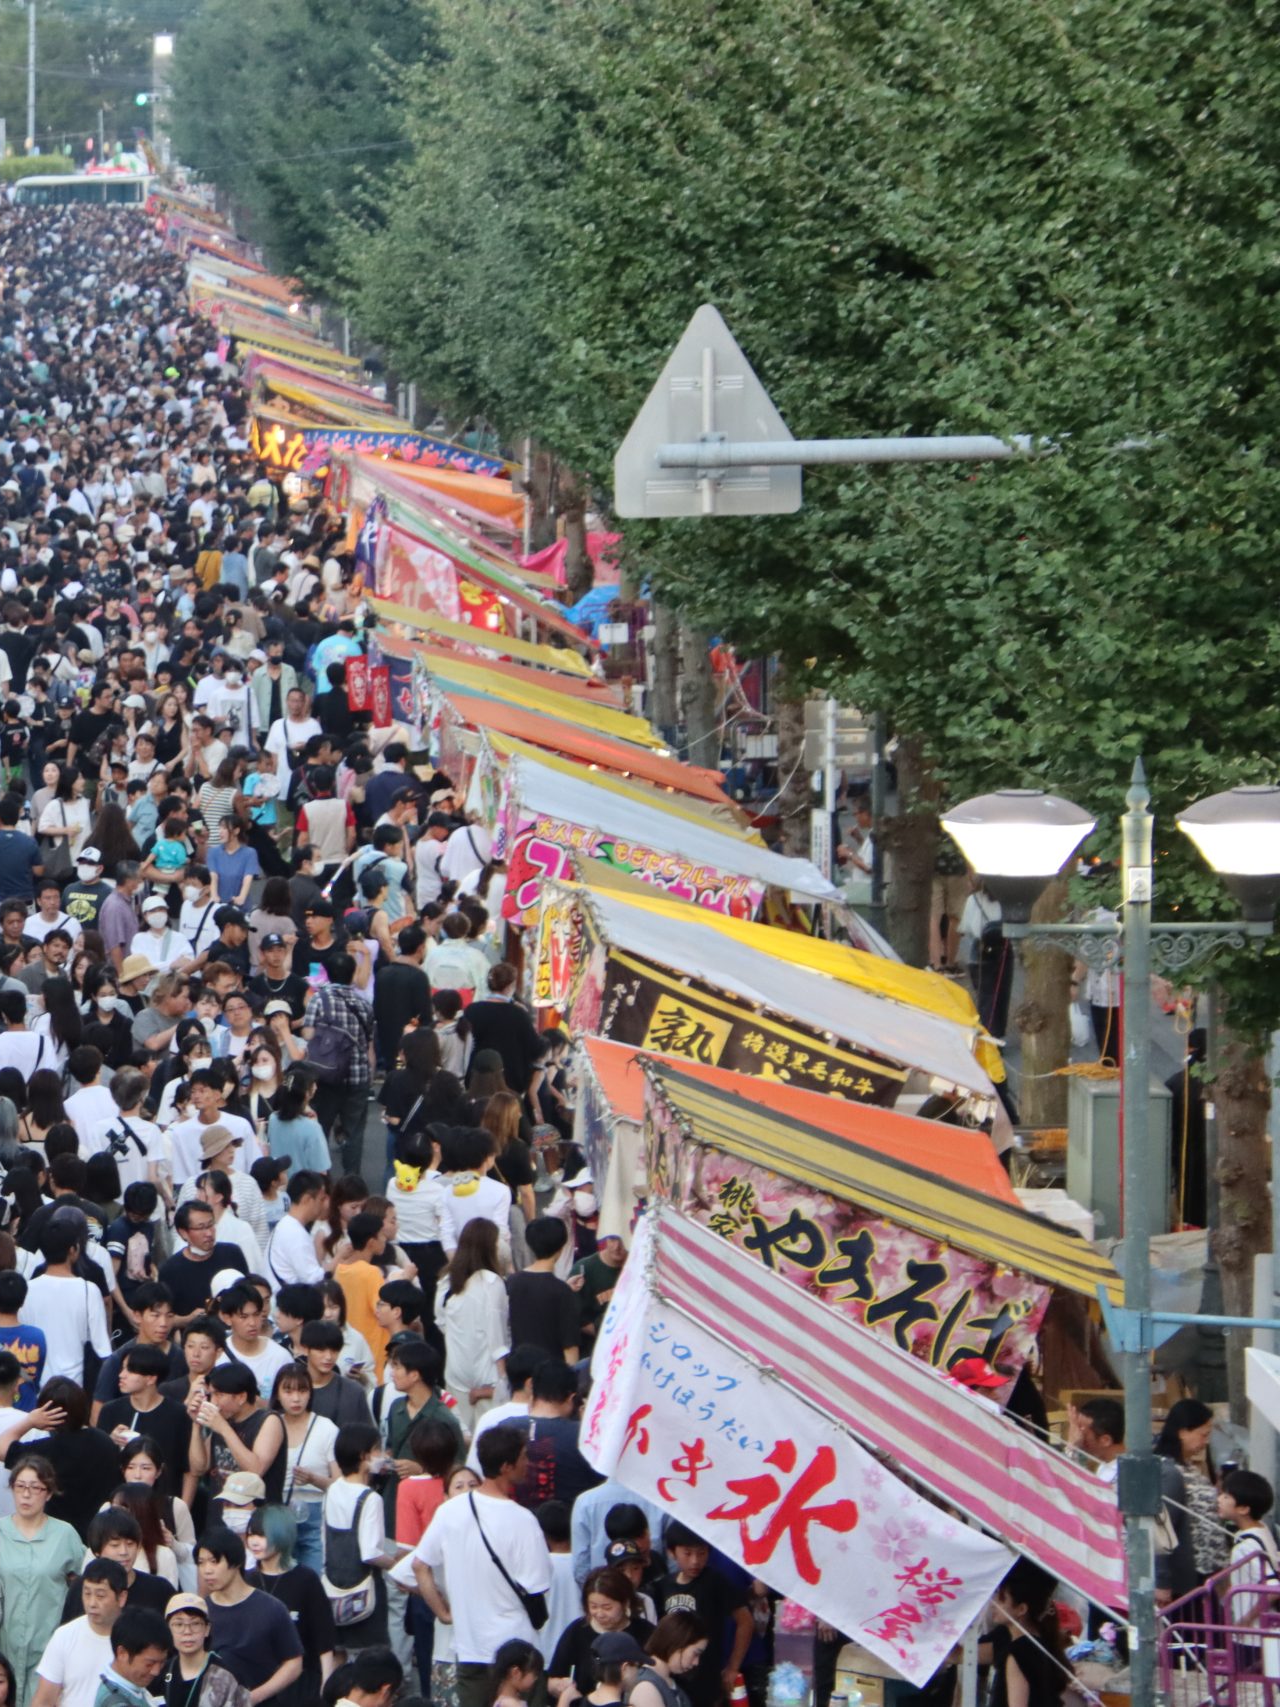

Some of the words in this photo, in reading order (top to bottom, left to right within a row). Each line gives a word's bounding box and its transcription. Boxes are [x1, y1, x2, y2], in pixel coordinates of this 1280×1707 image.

[741, 1031, 875, 1097] 特選黒毛和牛
[744, 1209, 1033, 1368] やきそば
